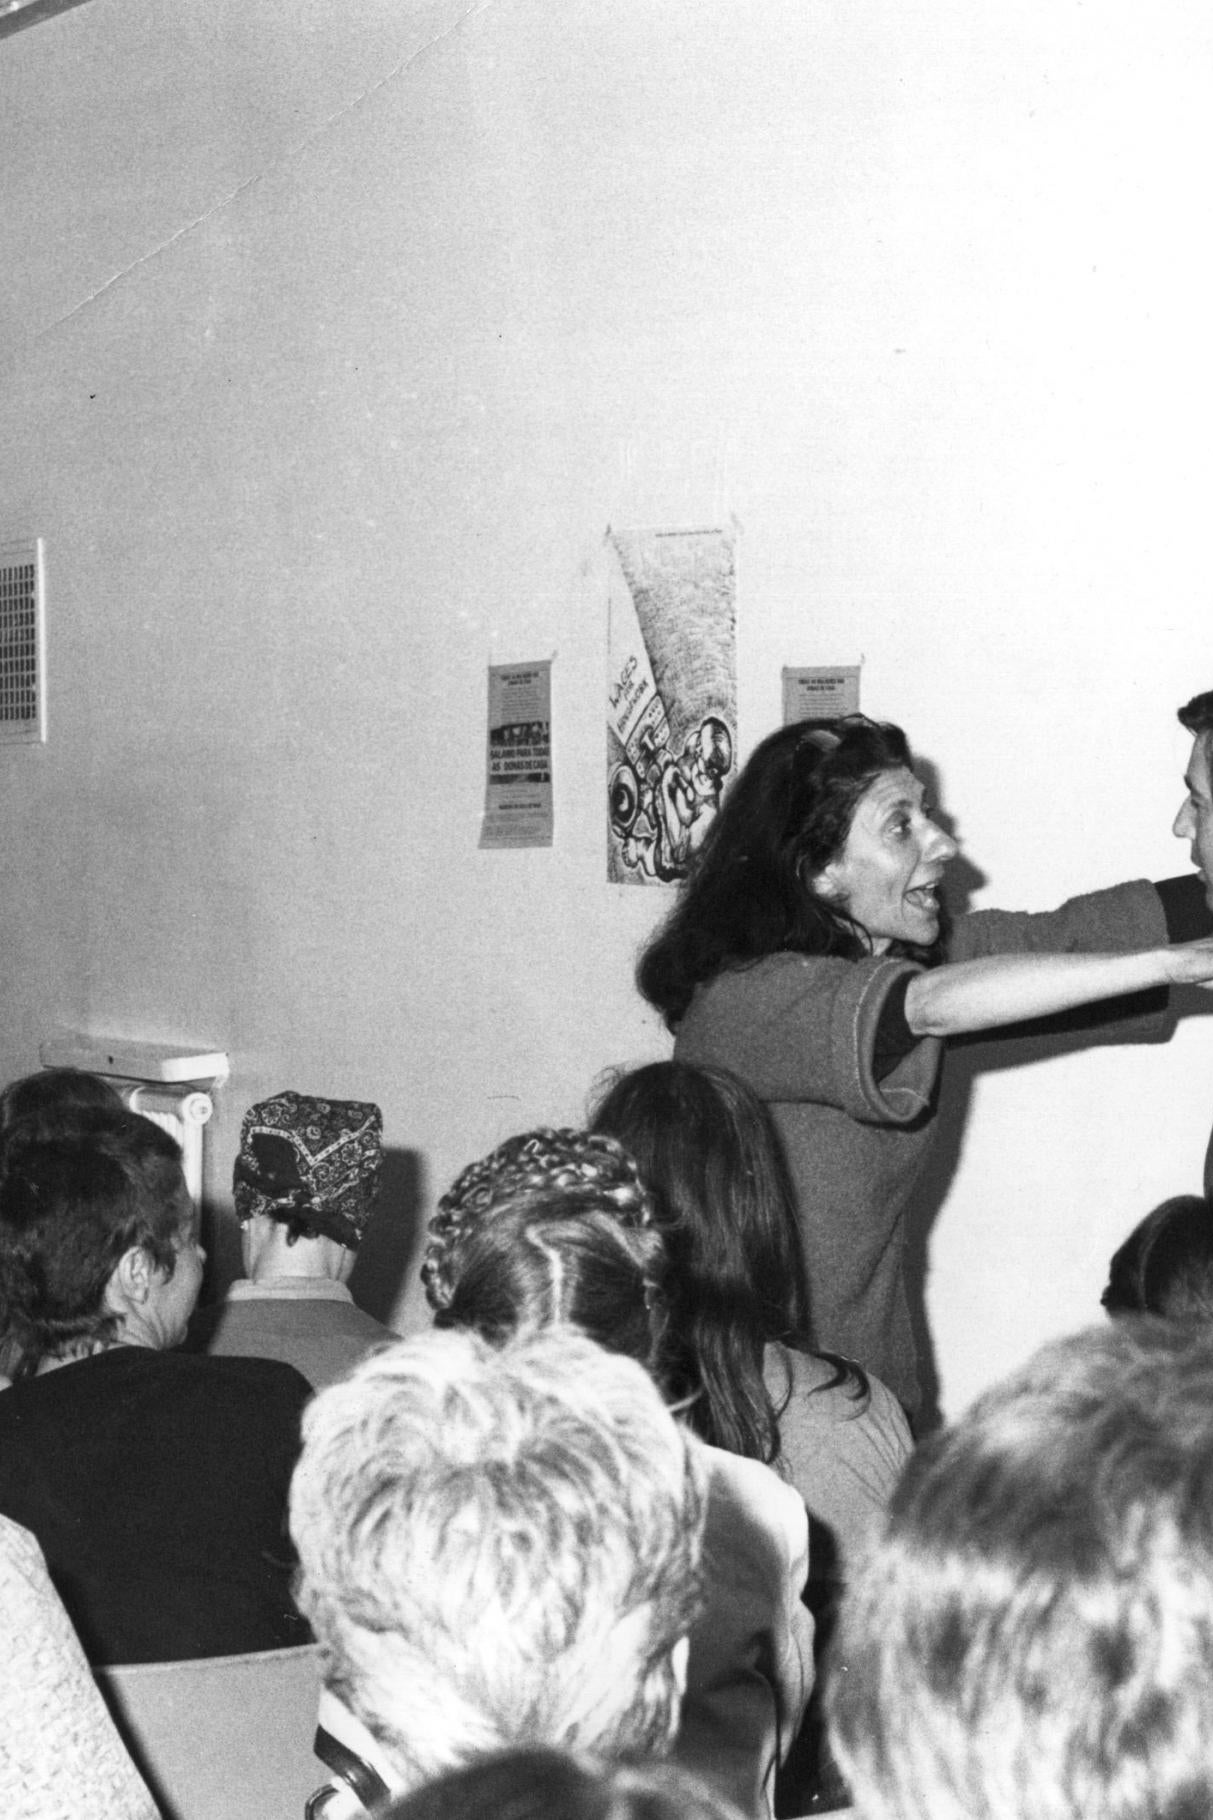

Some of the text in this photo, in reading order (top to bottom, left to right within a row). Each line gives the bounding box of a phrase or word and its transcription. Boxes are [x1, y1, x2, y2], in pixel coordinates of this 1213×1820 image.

[516, 748, 531, 758] PARA
[492, 761, 501, 771] AS
[504, 760, 523, 770] DONAS
